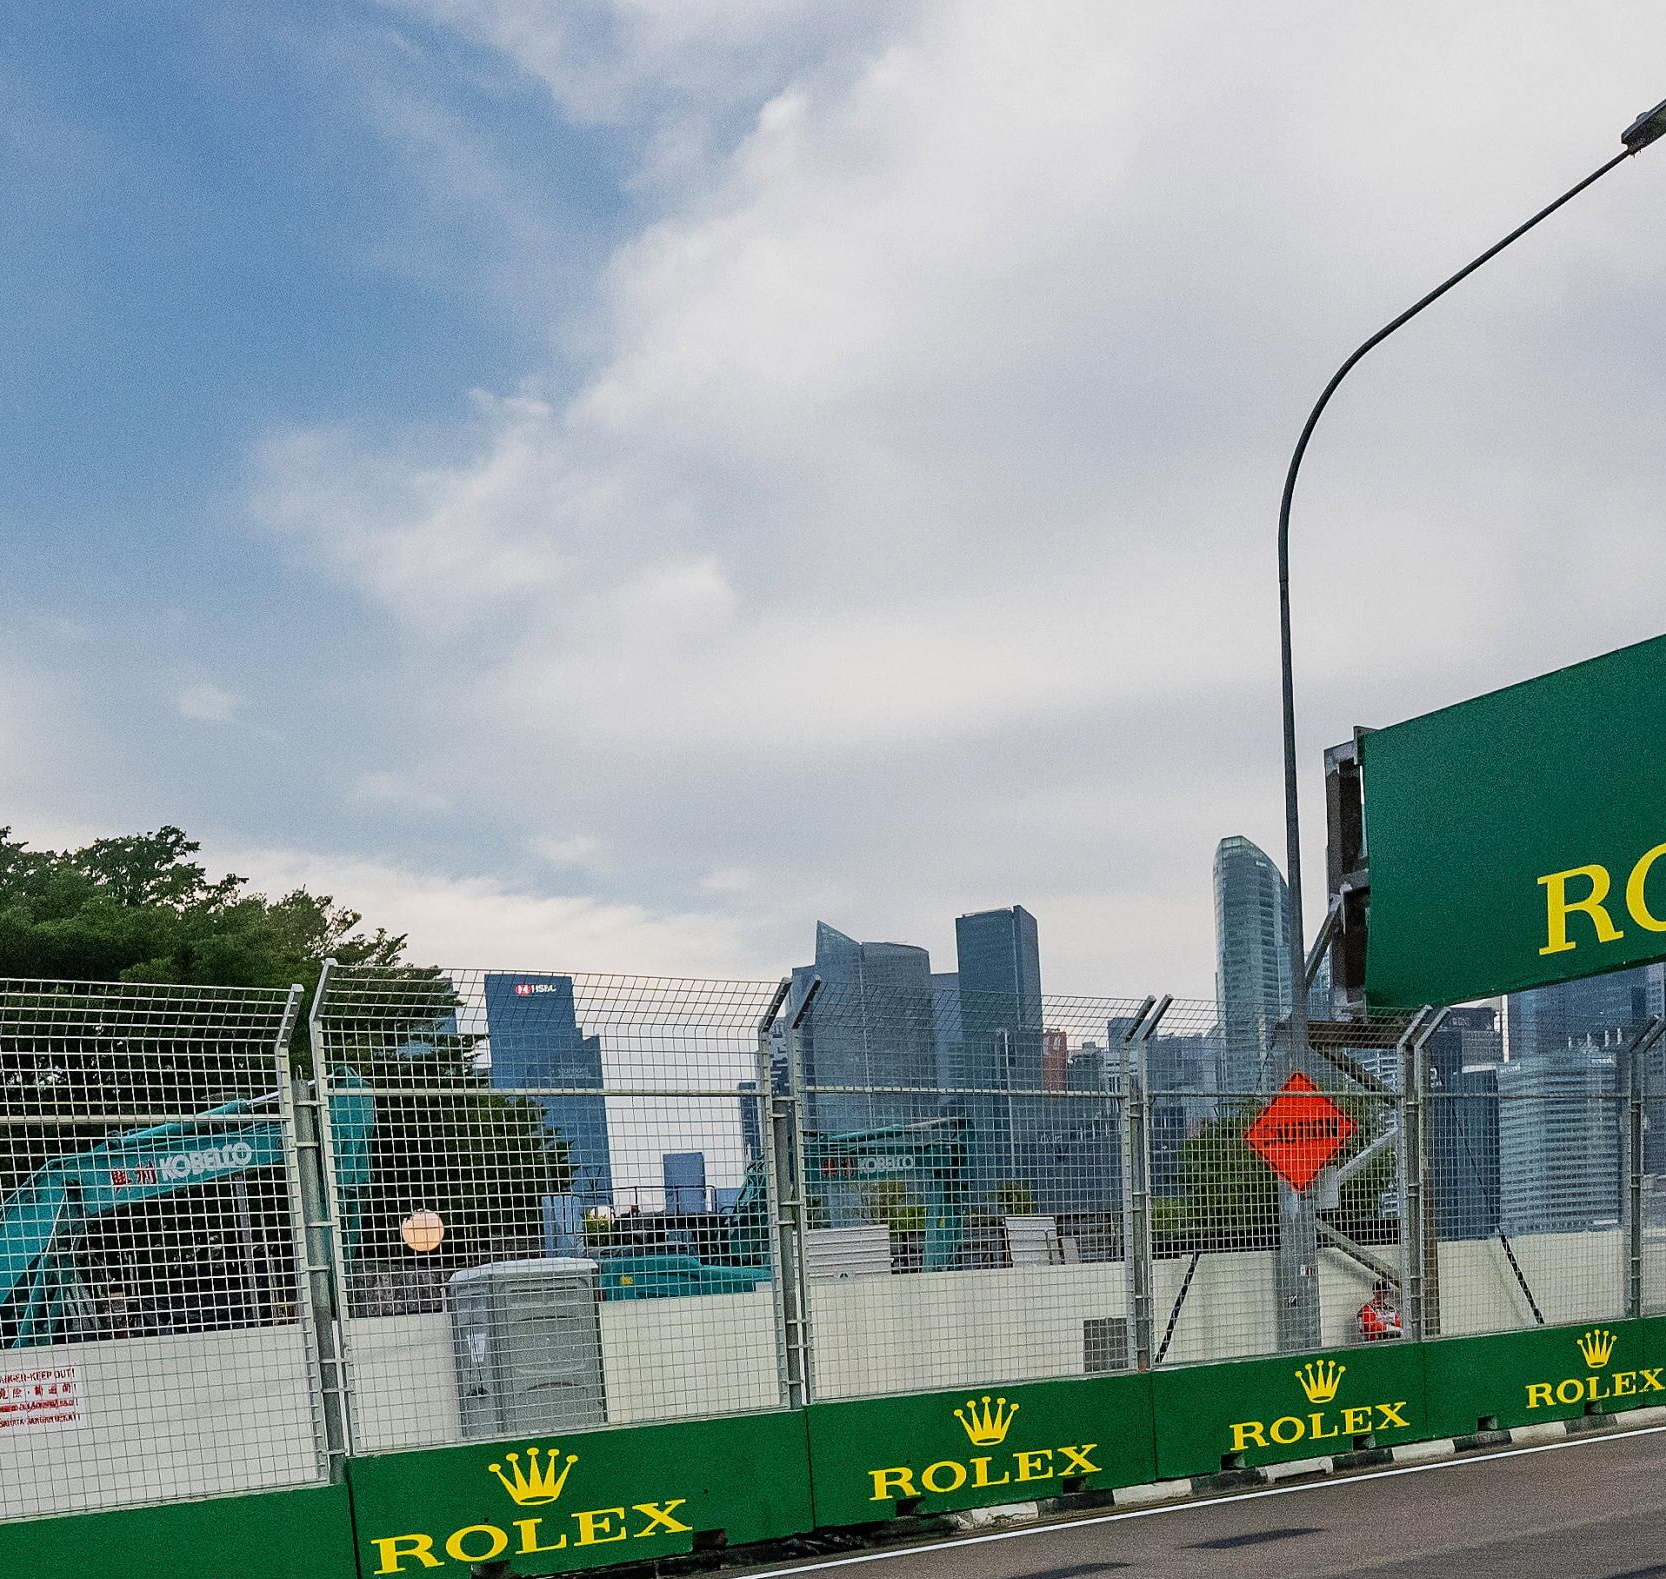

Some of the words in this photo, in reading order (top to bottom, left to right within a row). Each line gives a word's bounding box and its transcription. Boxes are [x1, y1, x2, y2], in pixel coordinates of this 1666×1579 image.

[159, 1142, 252, 1182] KOBELCO
[1524, 1367, 1666, 1410] ROLEX
[1229, 1400, 1411, 1452] ROLEX
[867, 1443, 1103, 1501] ROLEX
[370, 1498, 694, 1576] ROLEX
